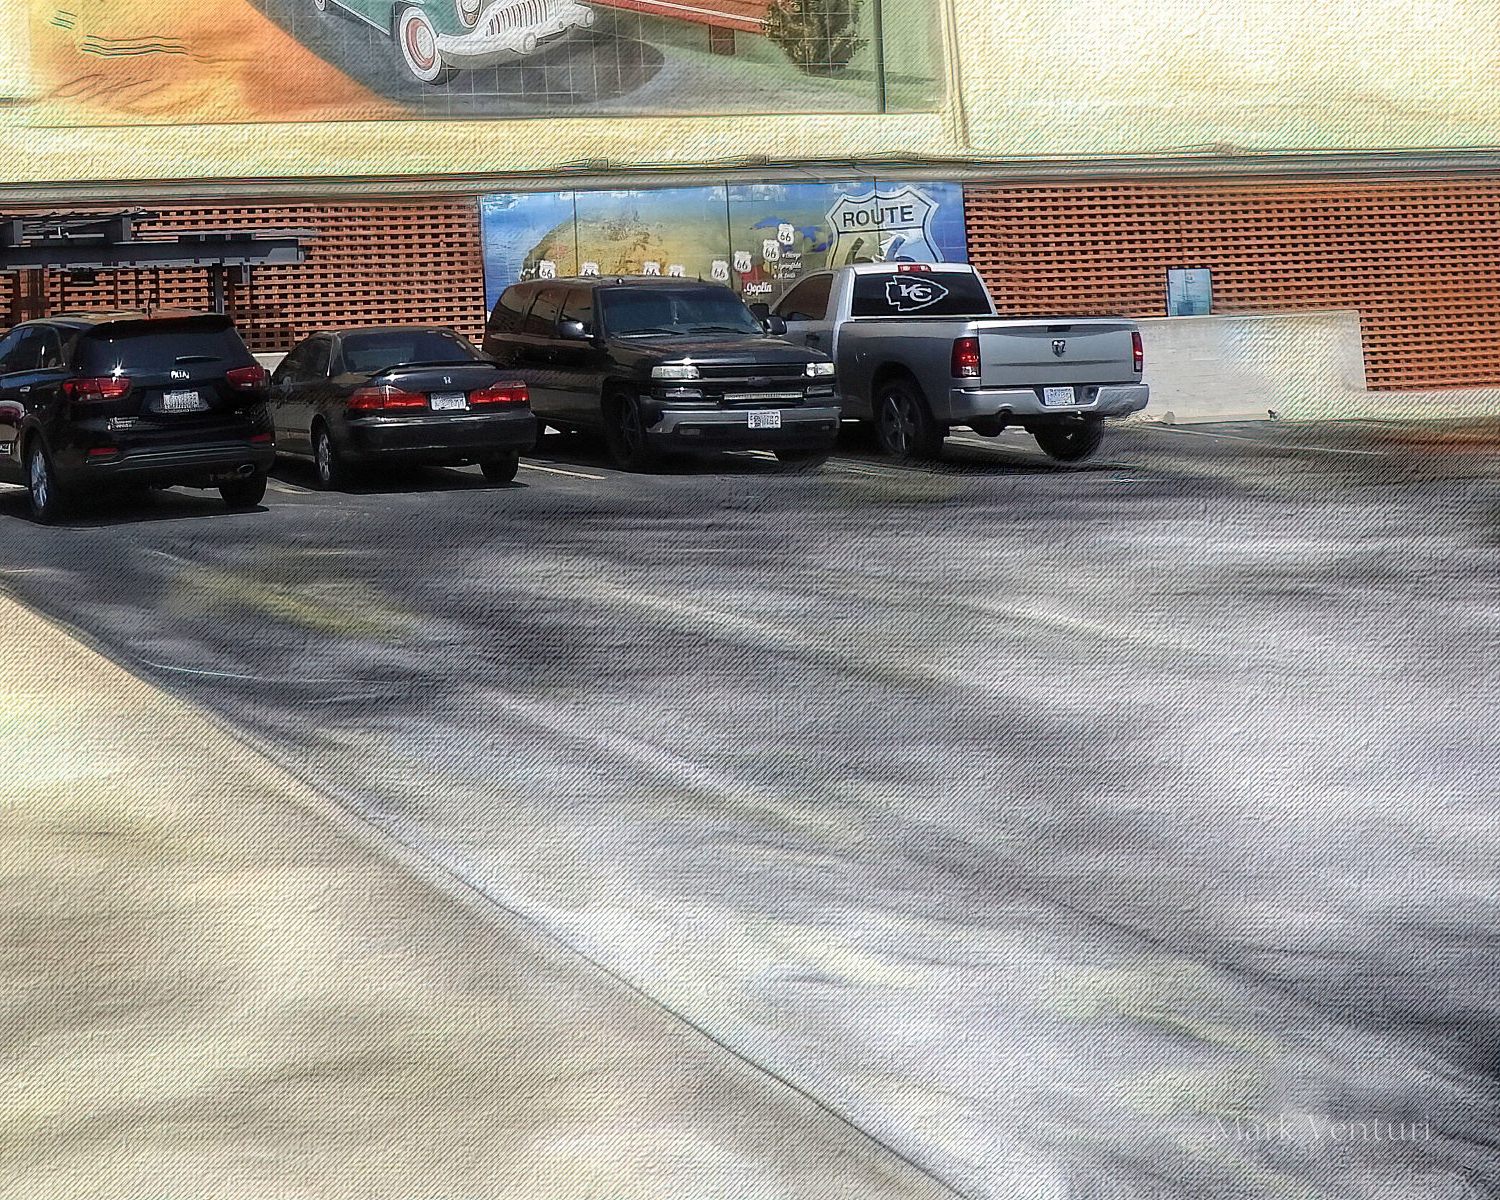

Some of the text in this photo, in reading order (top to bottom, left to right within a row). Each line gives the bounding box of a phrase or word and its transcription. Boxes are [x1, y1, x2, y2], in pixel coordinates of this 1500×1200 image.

[843, 205, 914, 227] ROUTE
[780, 232, 791, 242] 66
[765, 247, 777, 259] 66
[736, 259, 748, 270] 66
[541, 268, 553, 278] 66
[746, 282, 773, 296] Joplin
[898, 284, 932, 302] KC
